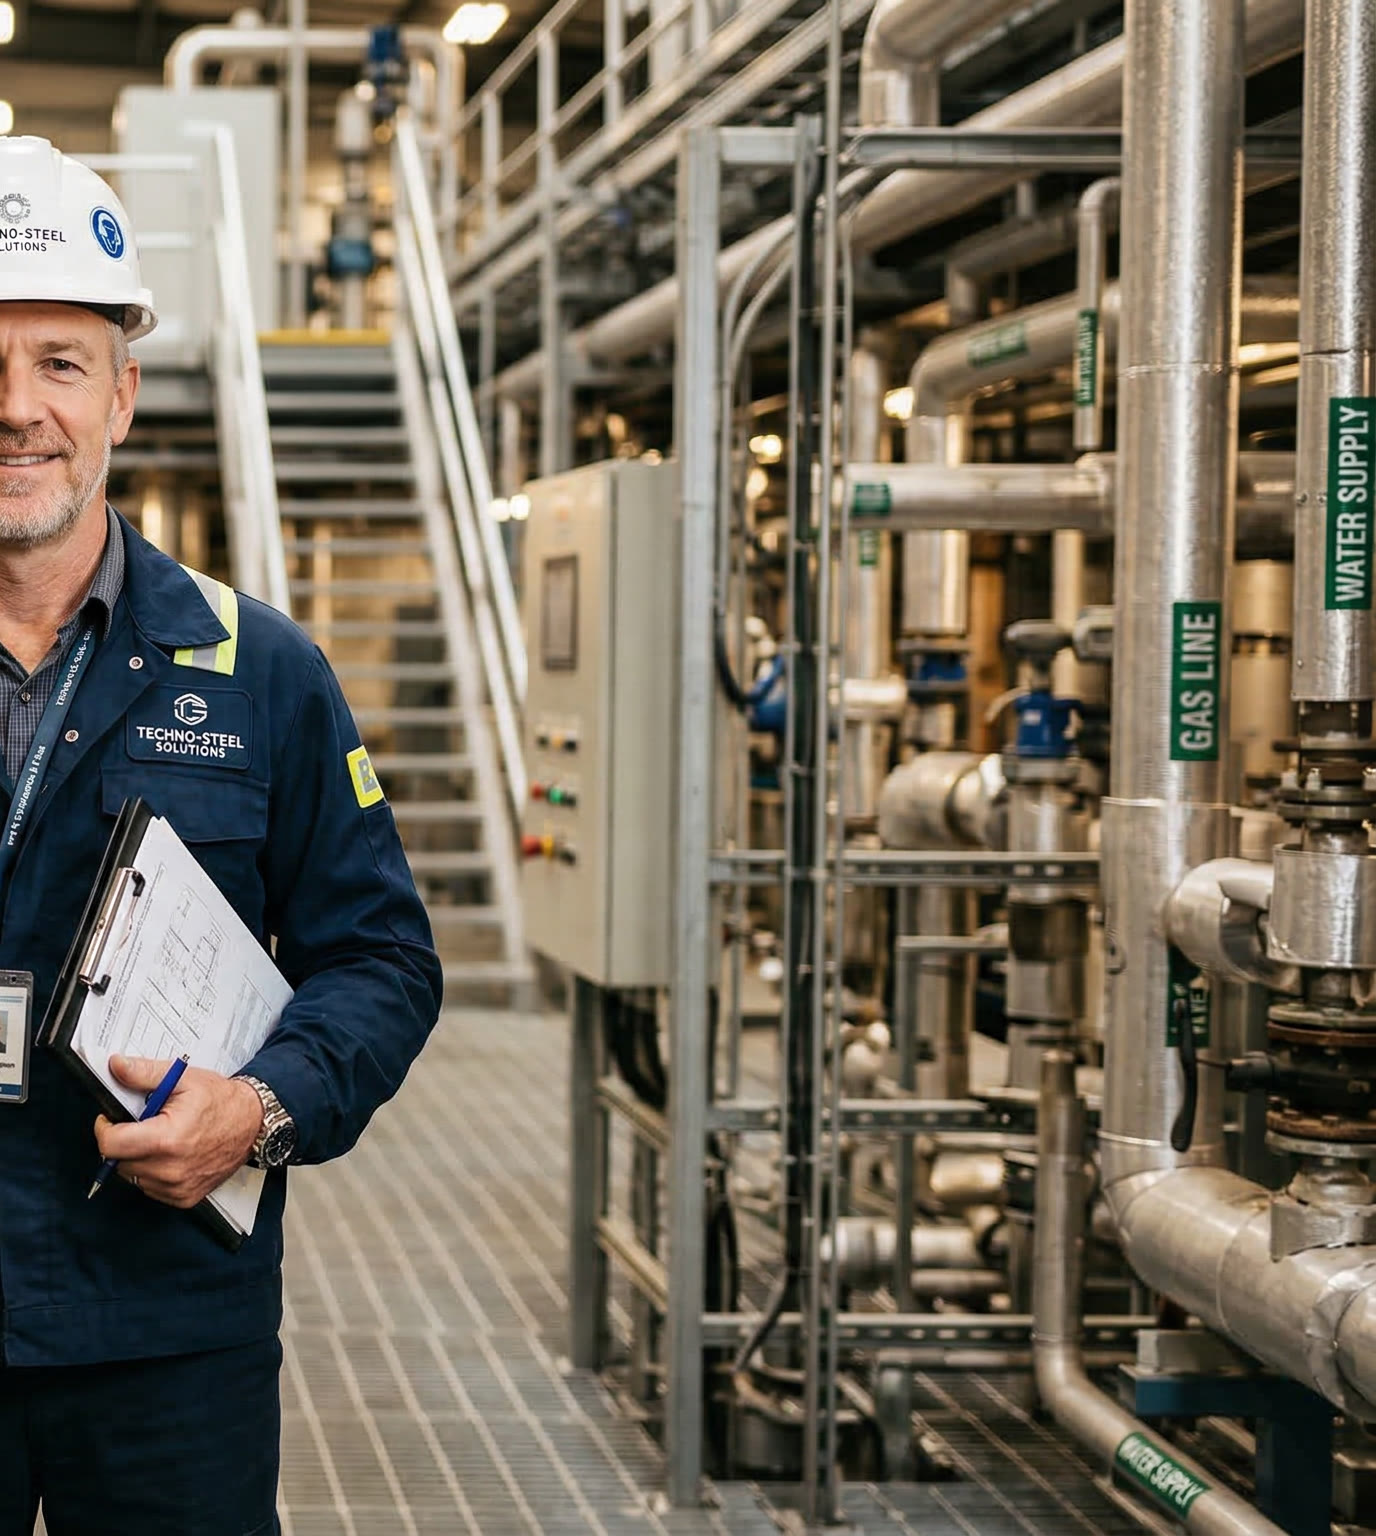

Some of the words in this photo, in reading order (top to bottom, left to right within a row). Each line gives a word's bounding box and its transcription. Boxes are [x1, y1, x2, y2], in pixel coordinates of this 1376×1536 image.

[1337, 406, 1369, 503] SUPPLY
[1335, 512, 1367, 602] WATER
[1180, 614, 1216, 680] LINE
[136, 726, 244, 749] TECHNO-STEEL
[155, 741, 226, 759] SOLUTIONS
[1179, 690, 1214, 751] GAS
[1118, 1436, 1164, 1479] WATER
[1150, 1461, 1203, 1508] SUPPLY
